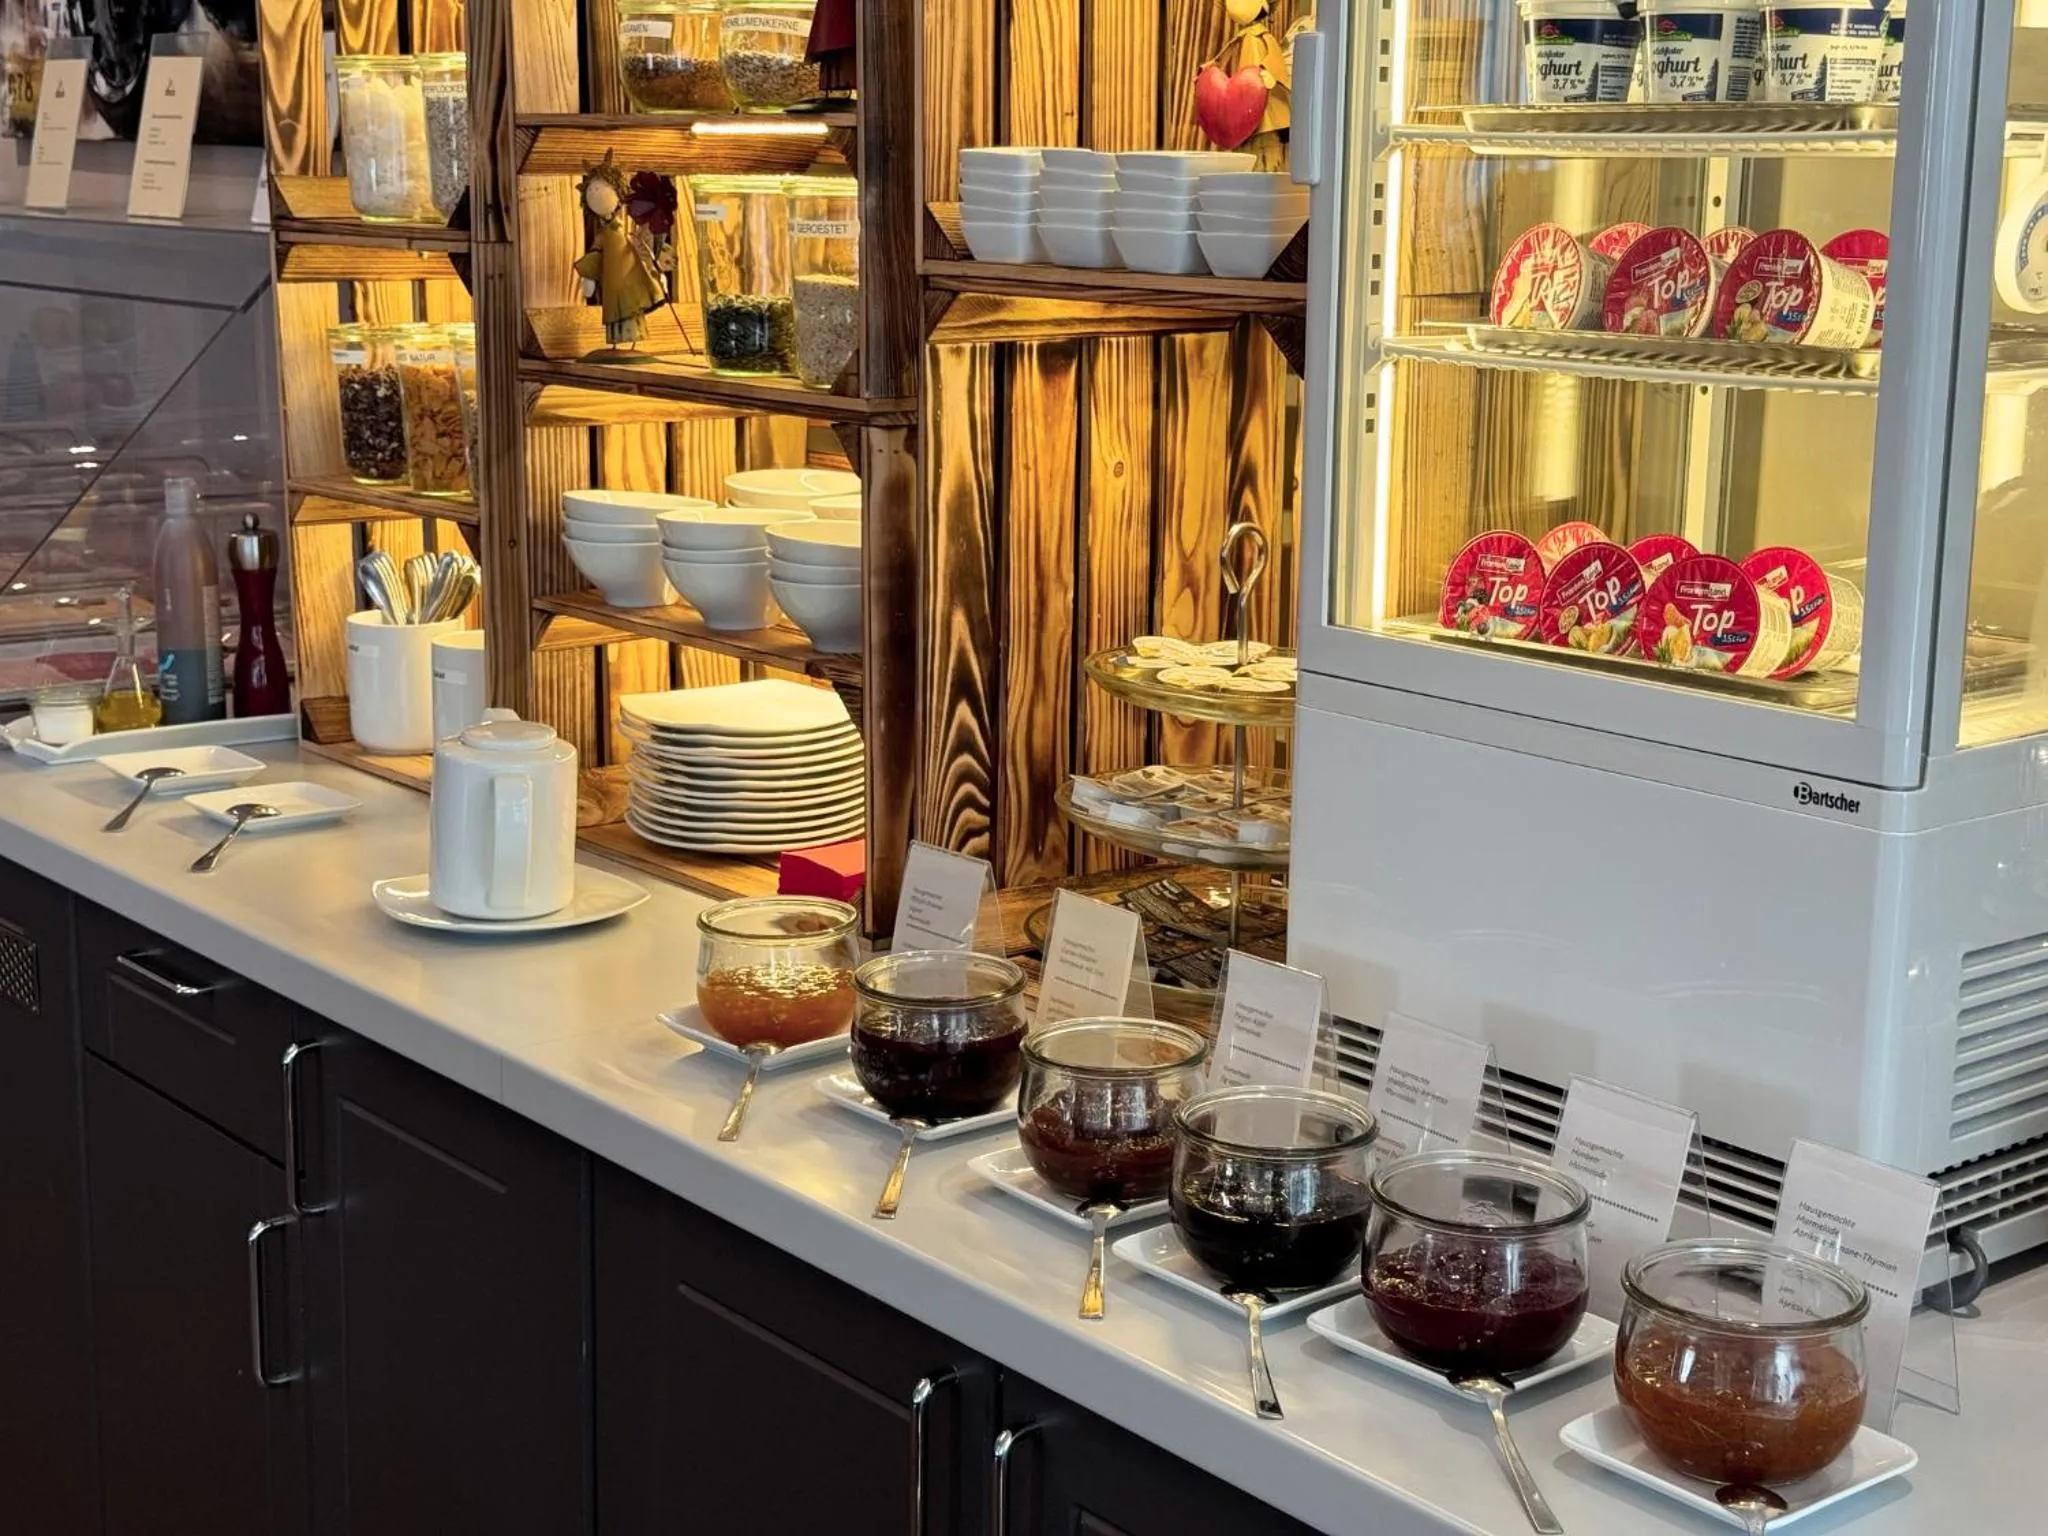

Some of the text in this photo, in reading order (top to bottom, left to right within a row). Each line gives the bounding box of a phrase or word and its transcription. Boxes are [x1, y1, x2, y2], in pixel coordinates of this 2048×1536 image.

[1647, 266, 1690, 309] Top
[1762, 281, 1804, 316] Top
[1488, 576, 1529, 609] Top
[1577, 576, 1621, 622] Top
[1690, 604, 1735, 639] Top
[1794, 782, 1860, 813] Bartscher
[1799, 1201, 1856, 1229] Hausgemachte
